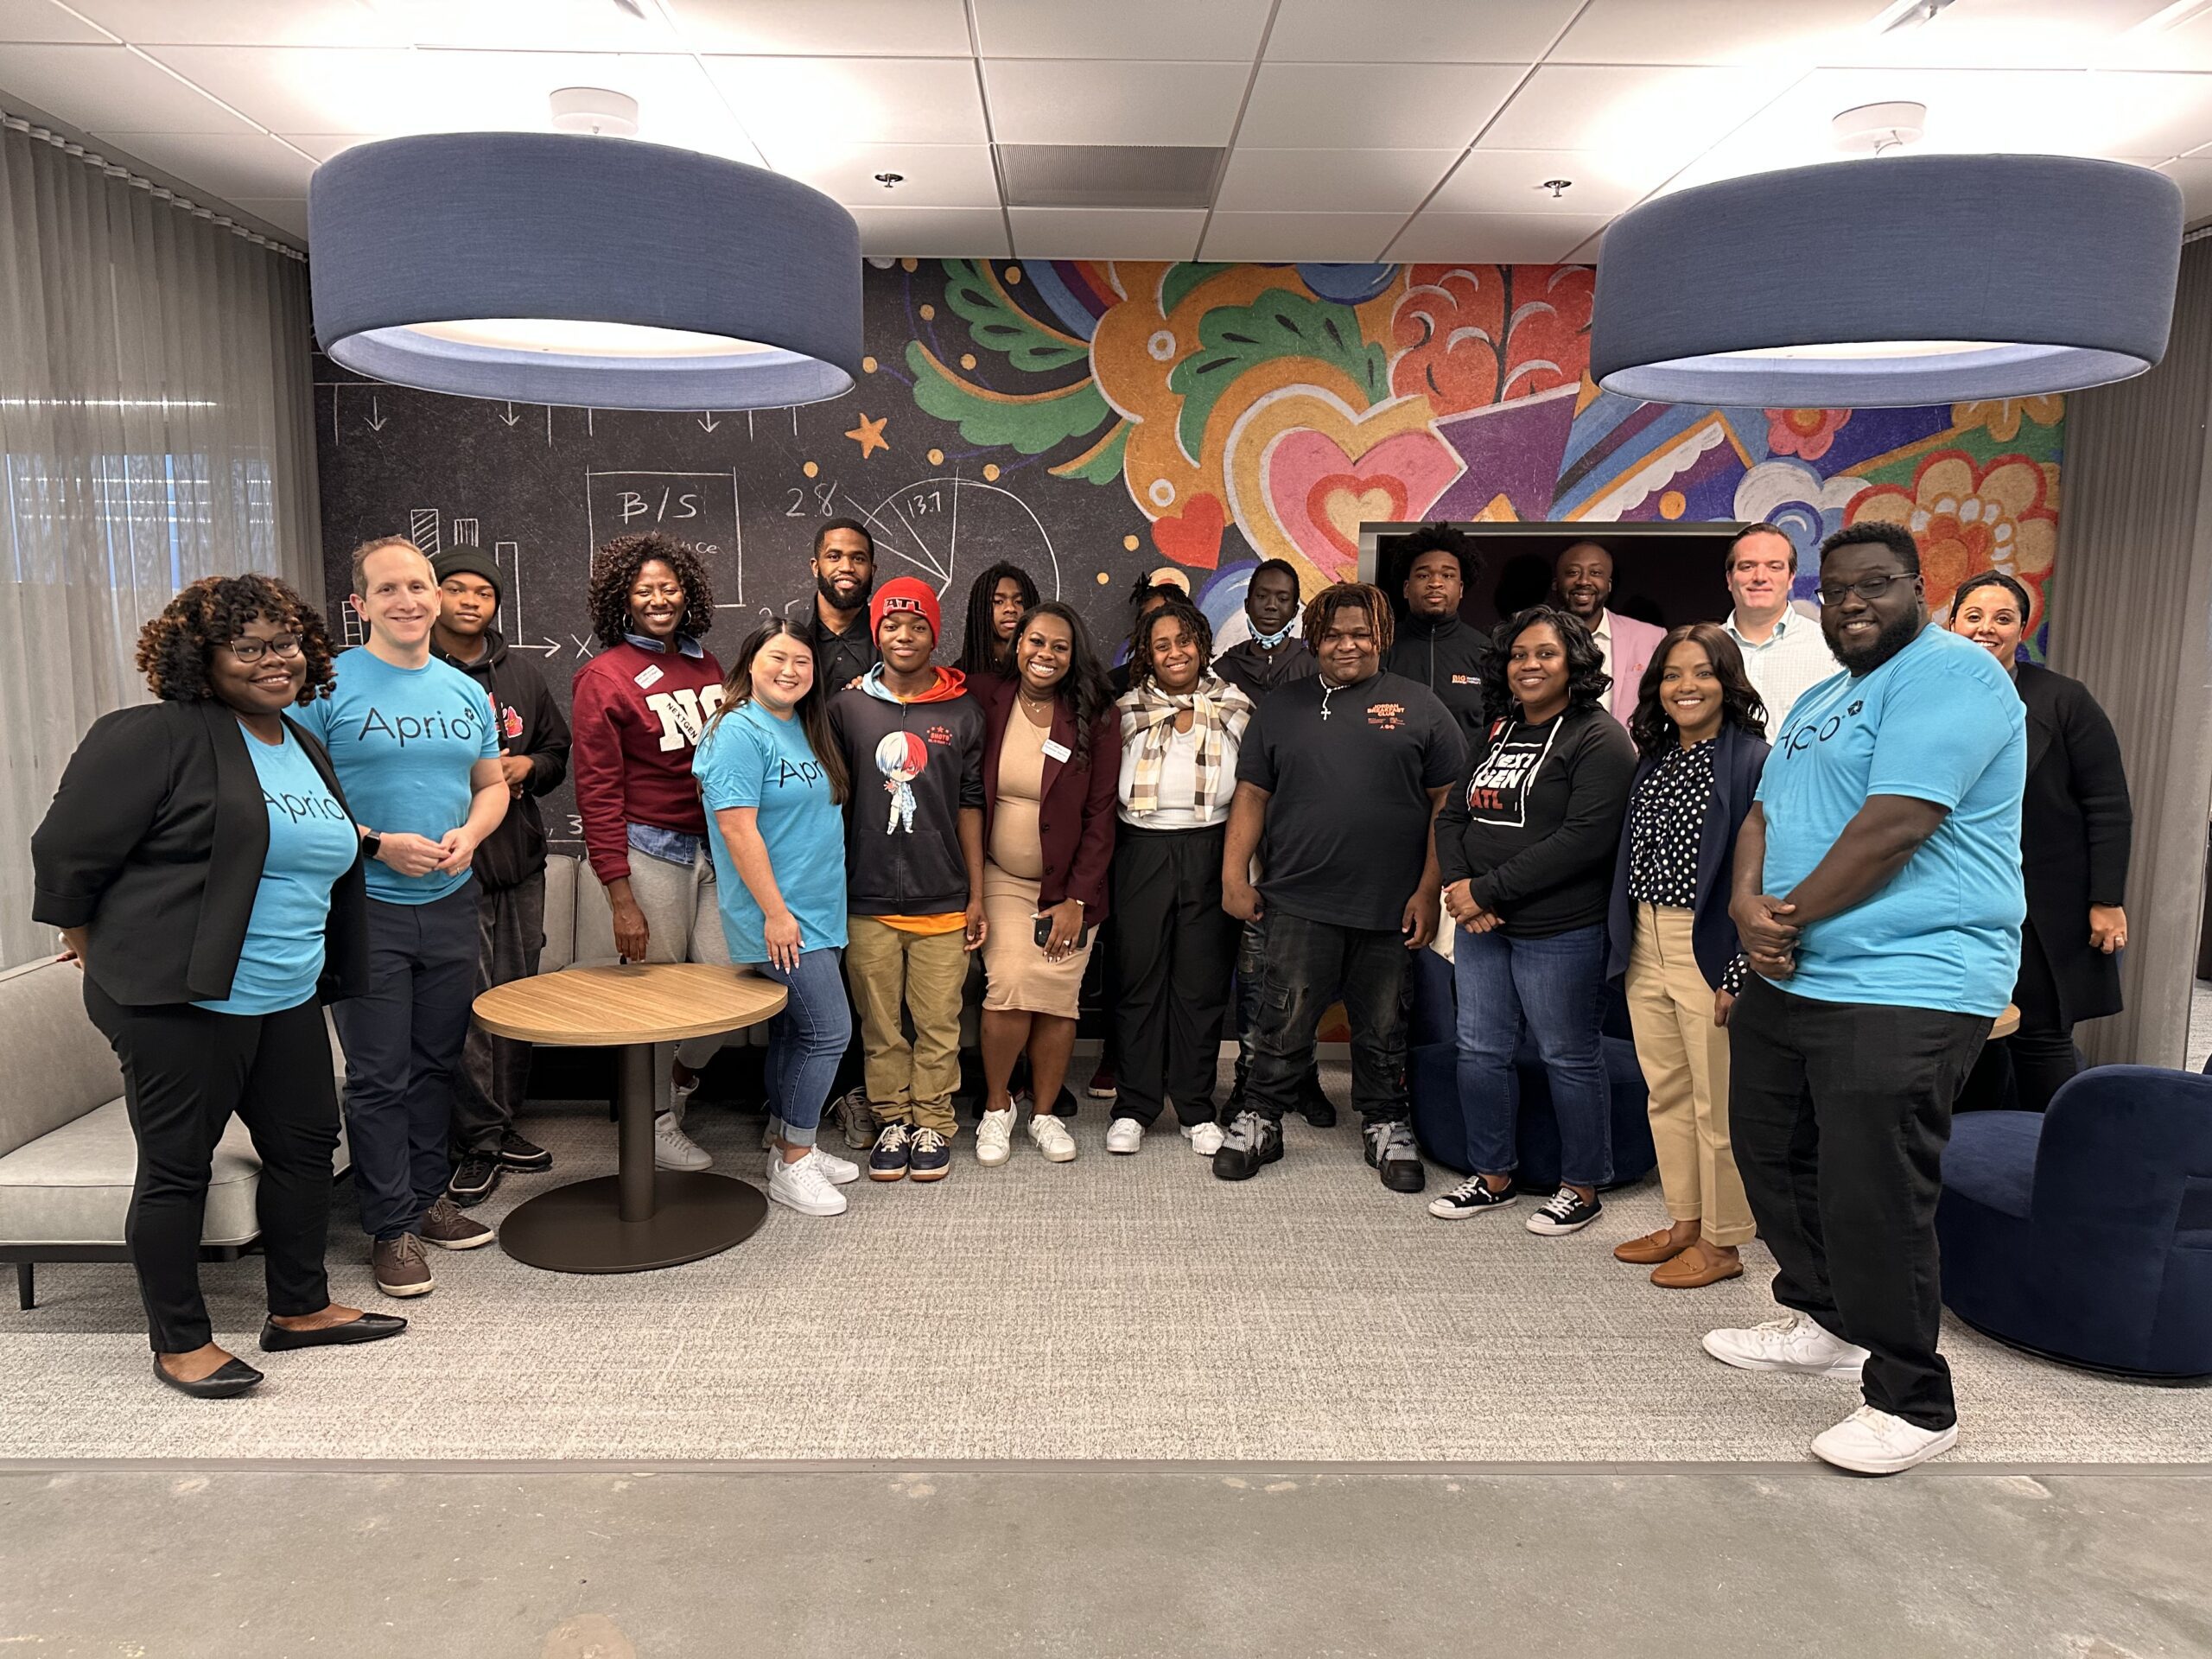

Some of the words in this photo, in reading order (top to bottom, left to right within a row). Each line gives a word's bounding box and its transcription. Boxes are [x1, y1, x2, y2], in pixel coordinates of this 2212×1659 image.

[883, 596, 927, 616] ATL
[359, 707, 471, 747] Aprio
[666, 702, 698, 739] NEXTGEN
[779, 758, 823, 788] Apr
[1470, 788, 1503, 810] ATL
